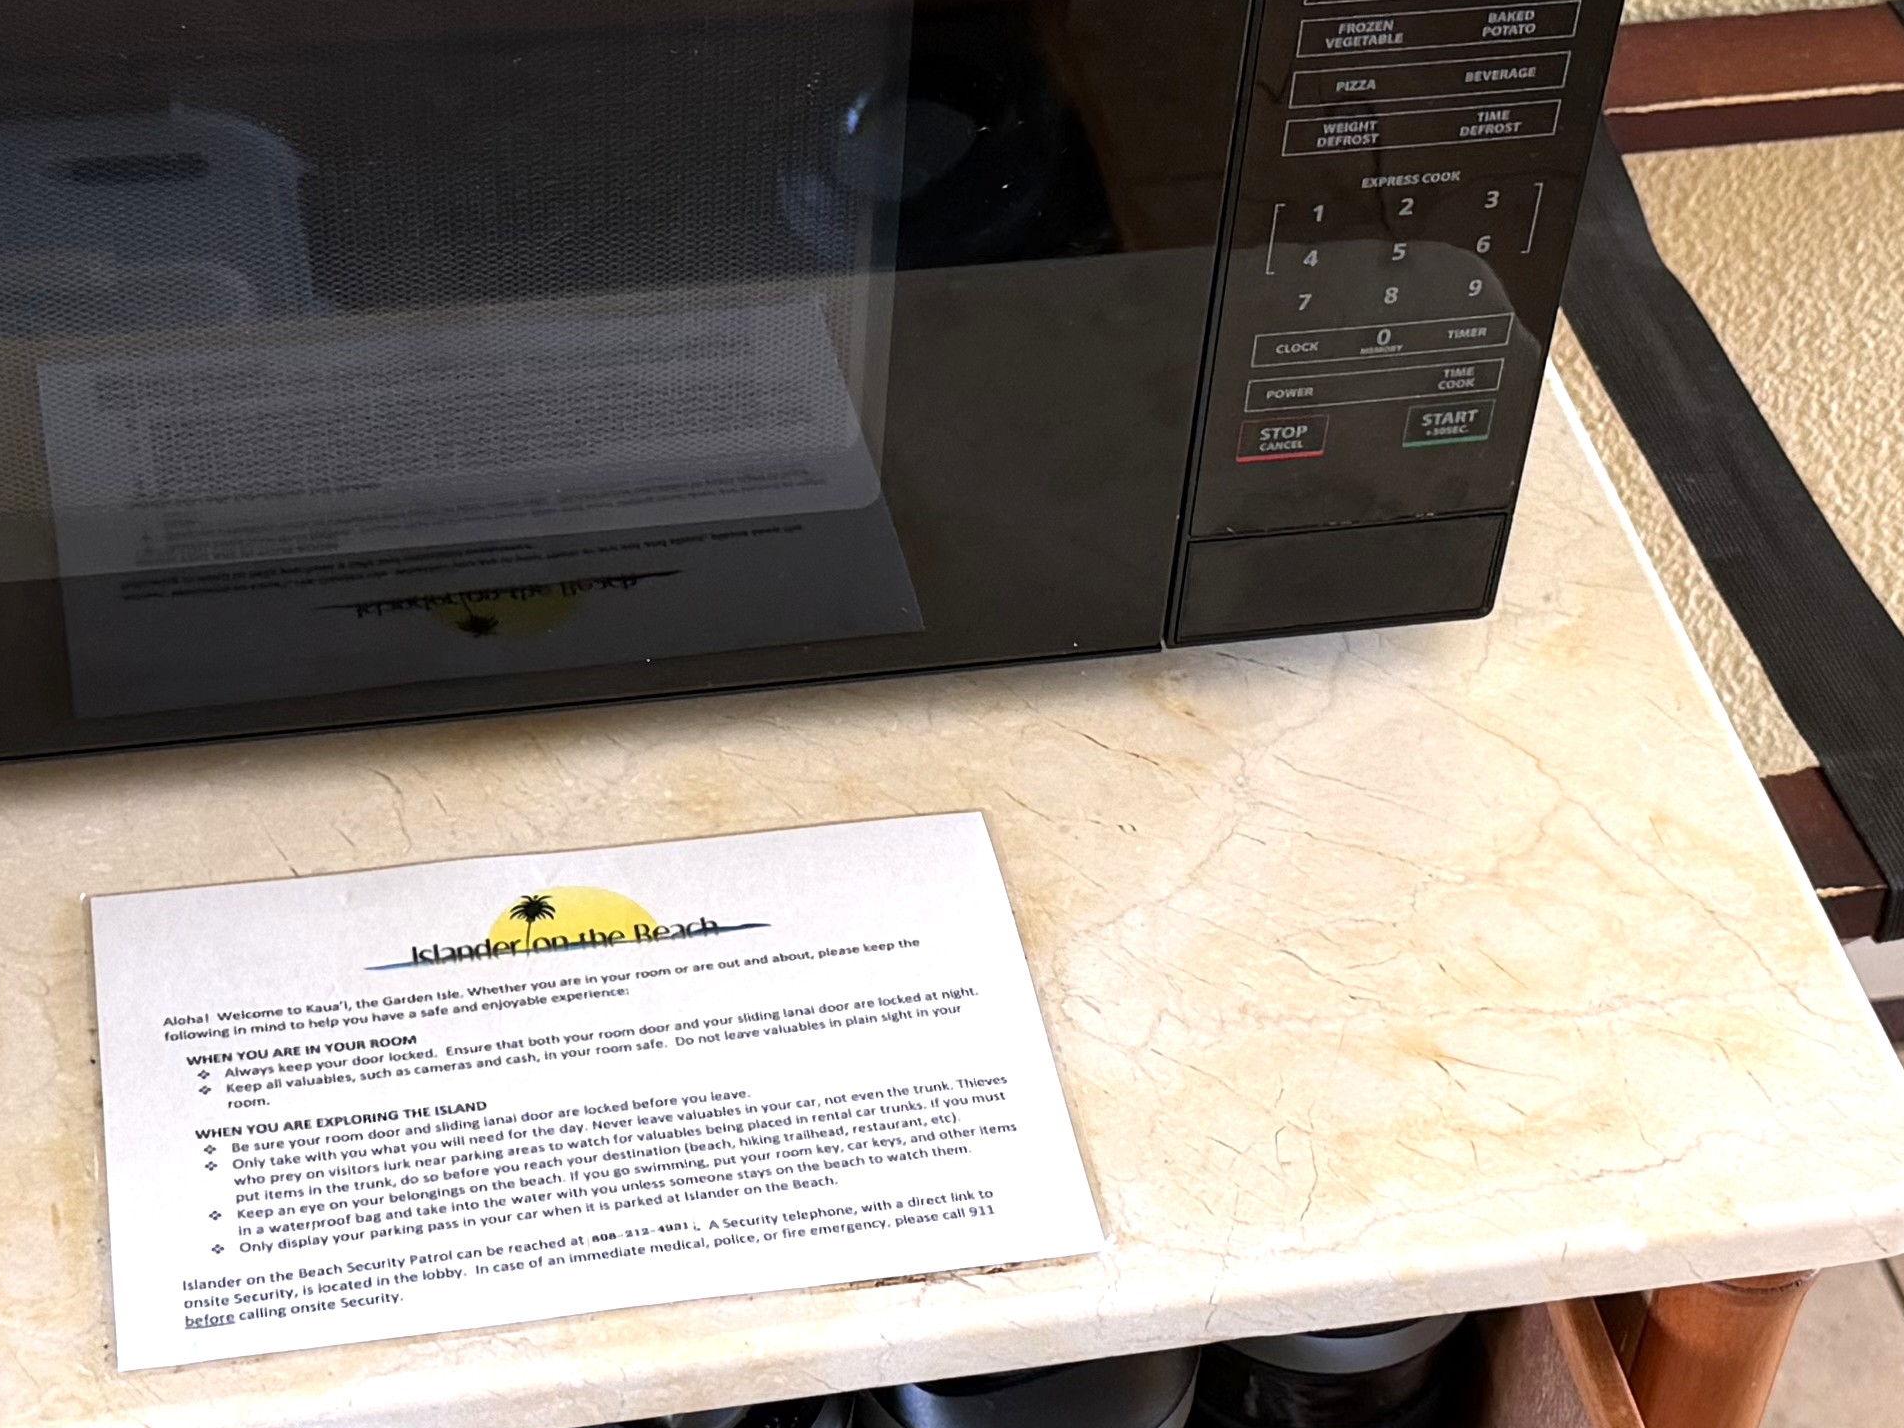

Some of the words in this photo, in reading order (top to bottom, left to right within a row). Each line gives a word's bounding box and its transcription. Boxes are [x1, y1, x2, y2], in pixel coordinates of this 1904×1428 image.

[1487, 10, 1536, 24] BAKED
[1338, 19, 1395, 35] FROZEN
[1481, 23, 1536, 38] POTATO
[1325, 33, 1404, 49] VEGETABLE
[1464, 66, 1537, 83] BEVERAGE
[1335, 79, 1377, 92] PIZZA
[1476, 110, 1511, 122] TIME
[1323, 120, 1379, 134] WEIGHT
[1459, 121, 1523, 138] DEFROST
[1316, 132, 1380, 148] DEFROST
[1361, 173, 1420, 189] EXPRESS
[1421, 170, 1461, 184] COOK
[1313, 204, 1324, 222] 1
[1398, 197, 1415, 216] 2
[1484, 190, 1500, 209] 3
[1303, 249, 1319, 267] 4
[1391, 243, 1407, 261] 5
[1476, 235, 1491, 253] 6
[1298, 293, 1313, 311] 7
[1383, 286, 1399, 304] 8
[1468, 279, 1483, 297] 9
[1376, 329, 1392, 346] 0
[1447, 327, 1488, 339] TIMER
[1275, 341, 1320, 355] CLOCK
[1443, 367, 1475, 378] TIME
[1437, 378, 1476, 391] COOK
[1266, 387, 1314, 400] POWER
[1421, 409, 1479, 427] START
[1259, 425, 1309, 441] STOP
[1259, 439, 1304, 453] CANCEL
[412, 935, 522, 965] Islander
[532, 930, 568, 953] on
[580, 927, 626, 948] the
[633, 916, 720, 943] Beach
[161, 1012, 209, 1027] Aloha!
[215, 1008, 283, 1021] Welcome
[285, 1006, 302, 1016] to
[354, 997, 379, 1009] the
[381, 992, 433, 1007] Garden
[465, 982, 527, 997] Whether
[529, 979, 557, 992] you
[558, 976, 581, 987] are
[584, 974, 598, 984] in
[599, 971, 631, 984] your
[634, 967, 672, 979] room
[673, 965, 689, 975] or
[691, 962, 714, 972] are
[716, 958, 741, 969] out
[743, 953, 769, 966] and
[771, 950, 815, 963] about,
[817, 945, 860, 959] please
[861, 941, 895, 952] keep
[897, 938, 920, 948] the
[184, 1051, 233, 1066] WHEN
[235, 1047, 269, 1061] YOU
[271, 1045, 301, 1058] ARE
[304, 1043, 321, 1055] IN
[323, 1039, 366, 1053] YOUR
[368, 1034, 417, 1049] ROOM
[226, 1097, 270, 1109] room.
[194, 1125, 243, 1140] WHEN
[245, 1121, 279, 1135] YOU
[282, 1118, 312, 1132] ARE
[315, 1109, 399, 1129] EXPLORING
[401, 1106, 431, 1119] THE
[433, 1100, 487, 1116] ISLAND
[230, 1141, 250, 1153] Be
[253, 1139, 285, 1151] sure
[287, 1135, 321, 1150] your
[324, 1132, 364, 1144] room
[366, 1127, 400, 1140] door
[404, 1122, 431, 1136] and
[434, 1118, 481, 1133] sliding
[519, 1109, 554, 1122] door
[557, 1107, 580, 1118] are
[582, 1099, 629, 1115] locked
[631, 1096, 678, 1110] before
[680, 1094, 707, 1106] you
[709, 1089, 750, 1101] leave.
[238, 1240, 273, 1253] Only
[276, 1234, 329, 1250] display
[331, 1230, 365, 1245] your
[369, 1223, 424, 1240] parking
[426, 1219, 459, 1233] pass
[462, 1216, 477, 1227] in
[479, 1213, 512, 1227] your
[515, 1209, 538, 1221] car
[541, 1205, 582, 1218] when
[584, 1202, 595, 1212] it
[598, 1201, 610, 1211] is
[613, 1193, 663, 1211] parked
[666, 1192, 681, 1204] at
[683, 1186, 739, 1201] Islander
[742, 1185, 762, 1195] on
[764, 1181, 788, 1193] the
[791, 1174, 838, 1190] Beach.
[184, 1313, 236, 1330] before
[238, 1306, 287, 1321] calling
[289, 1300, 336, 1314] onsite
[339, 1292, 403, 1308] Security.
